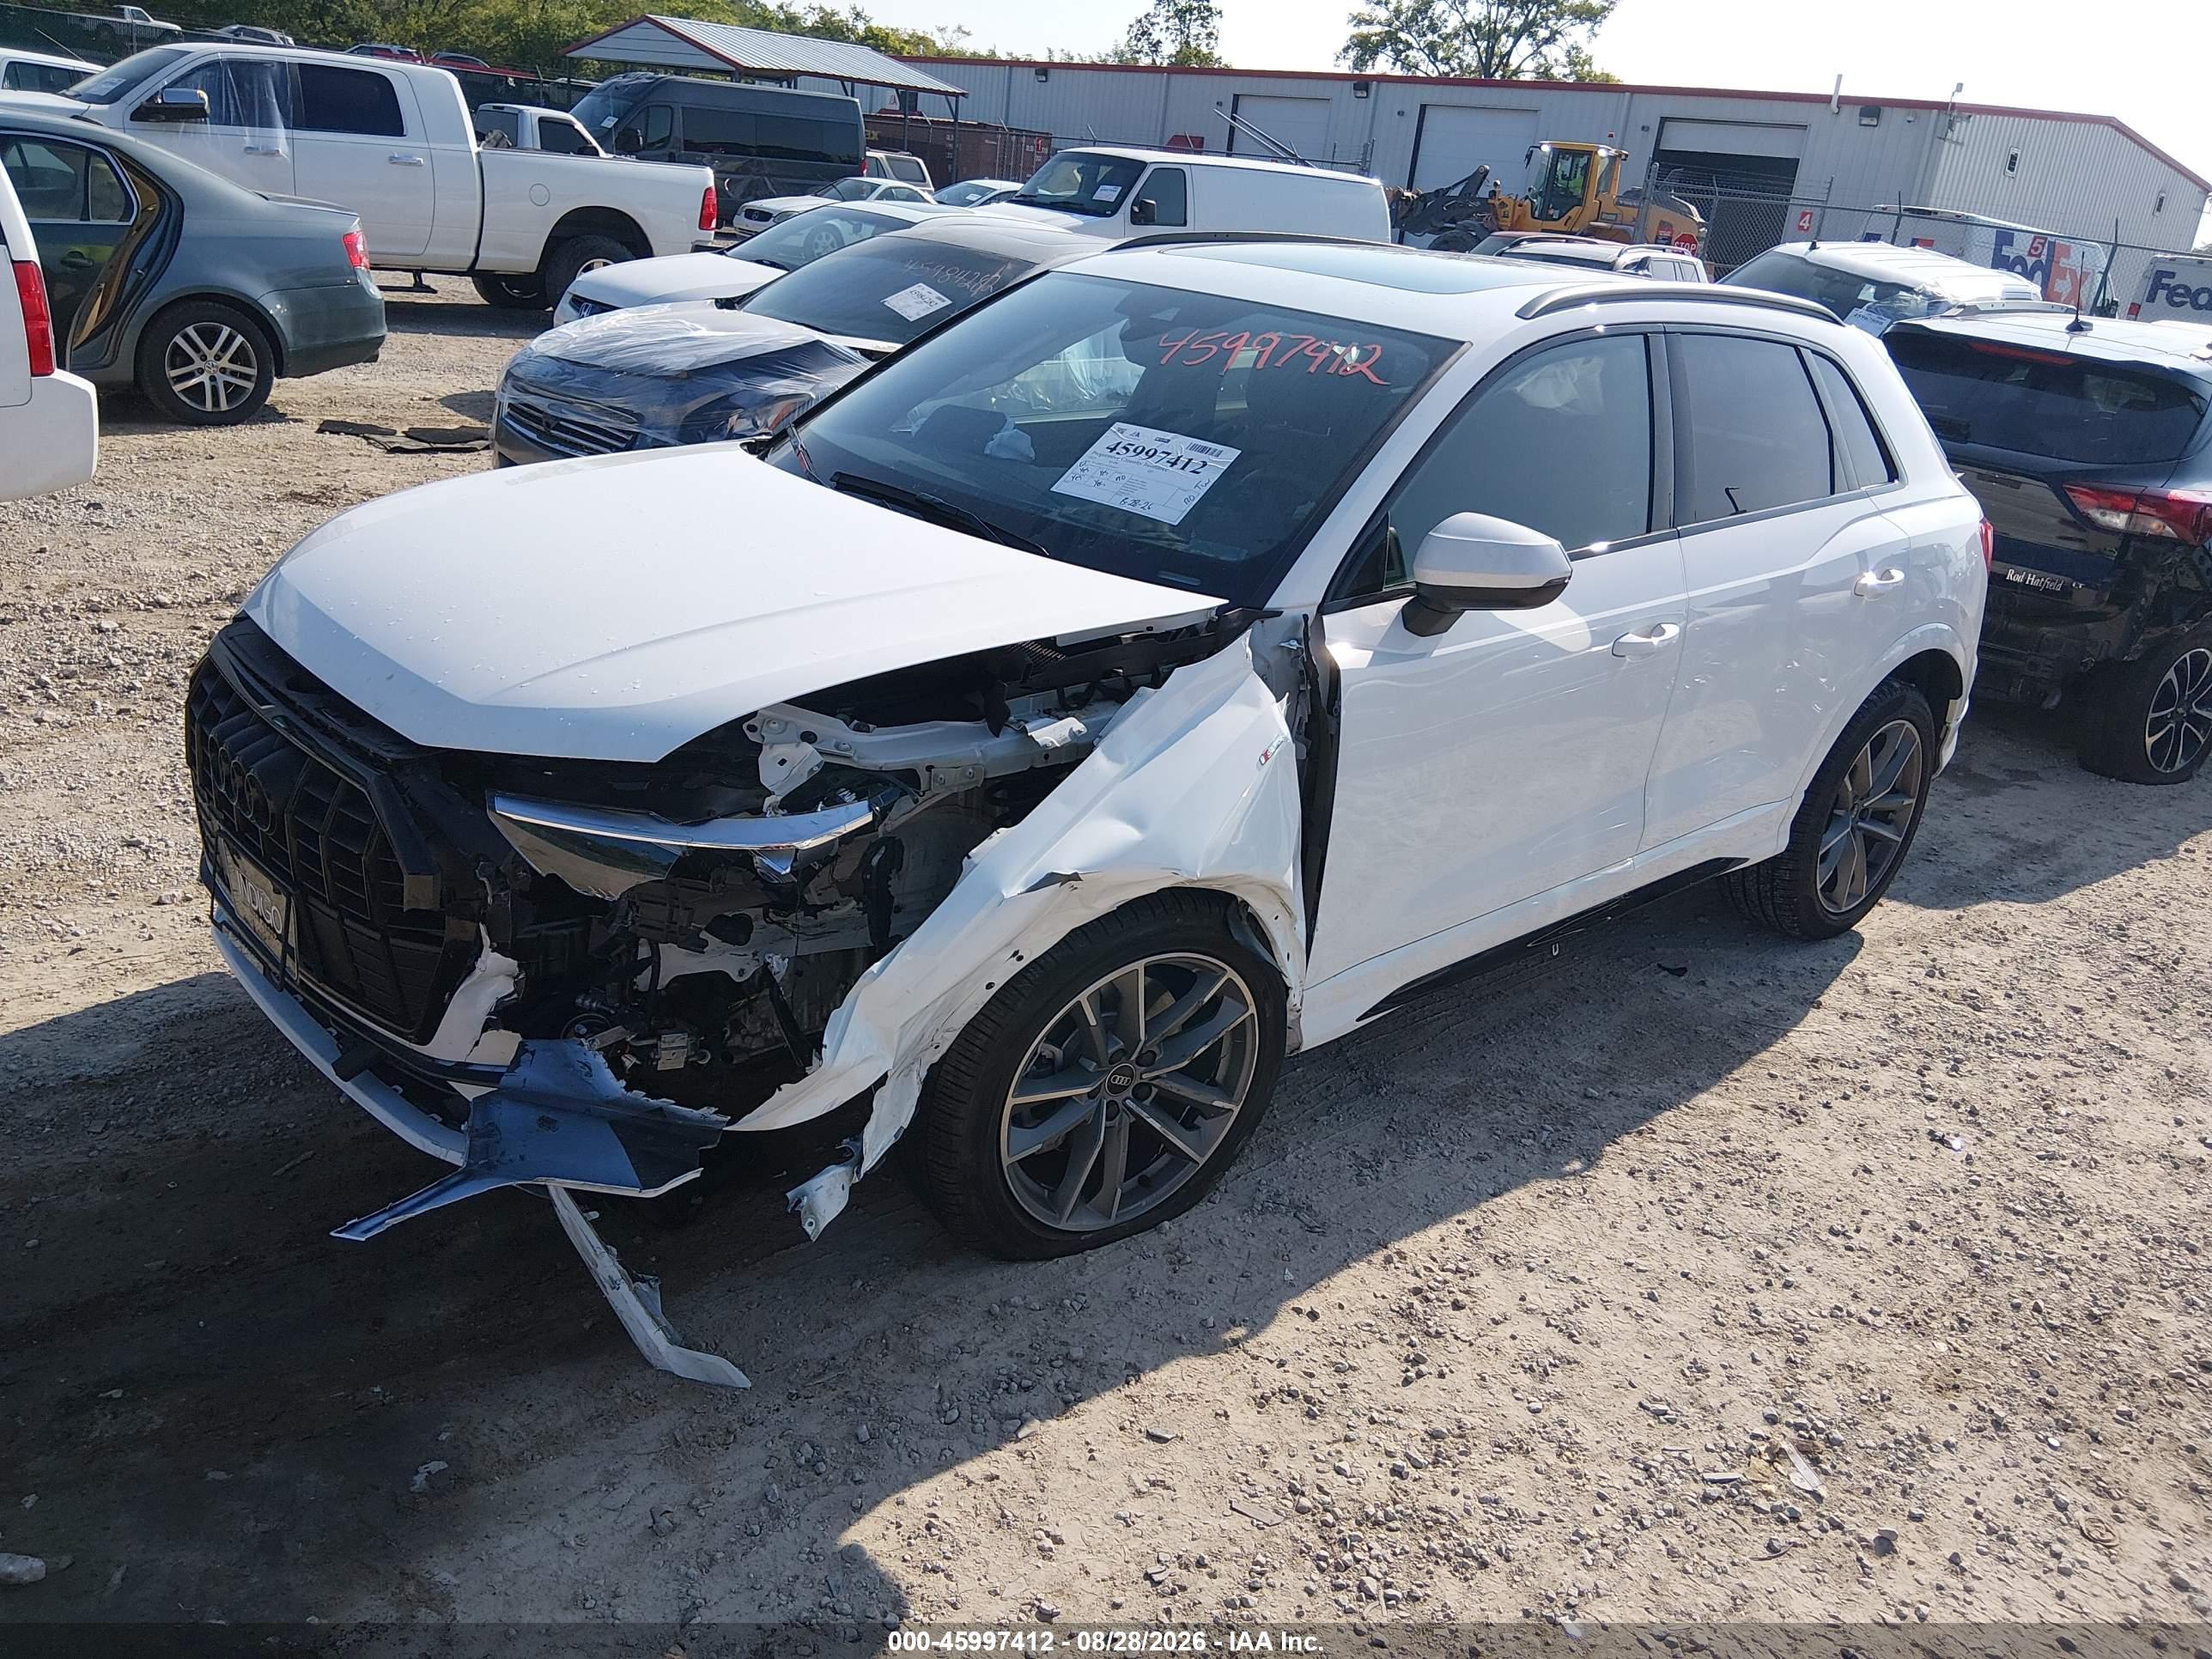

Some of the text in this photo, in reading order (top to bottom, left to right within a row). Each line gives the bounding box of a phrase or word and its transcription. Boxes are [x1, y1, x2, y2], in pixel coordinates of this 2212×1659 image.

[1799, 213, 1811, 229] 4
[2030, 239, 2044, 255] 5
[1991, 230, 2090, 311] FedEx
[1159, 330, 1391, 386] 45997412
[1106, 441, 1208, 474] 45997412
[2006, 568, 2064, 591] Rod Hatfield
[235, 868, 283, 935] INDIGO
